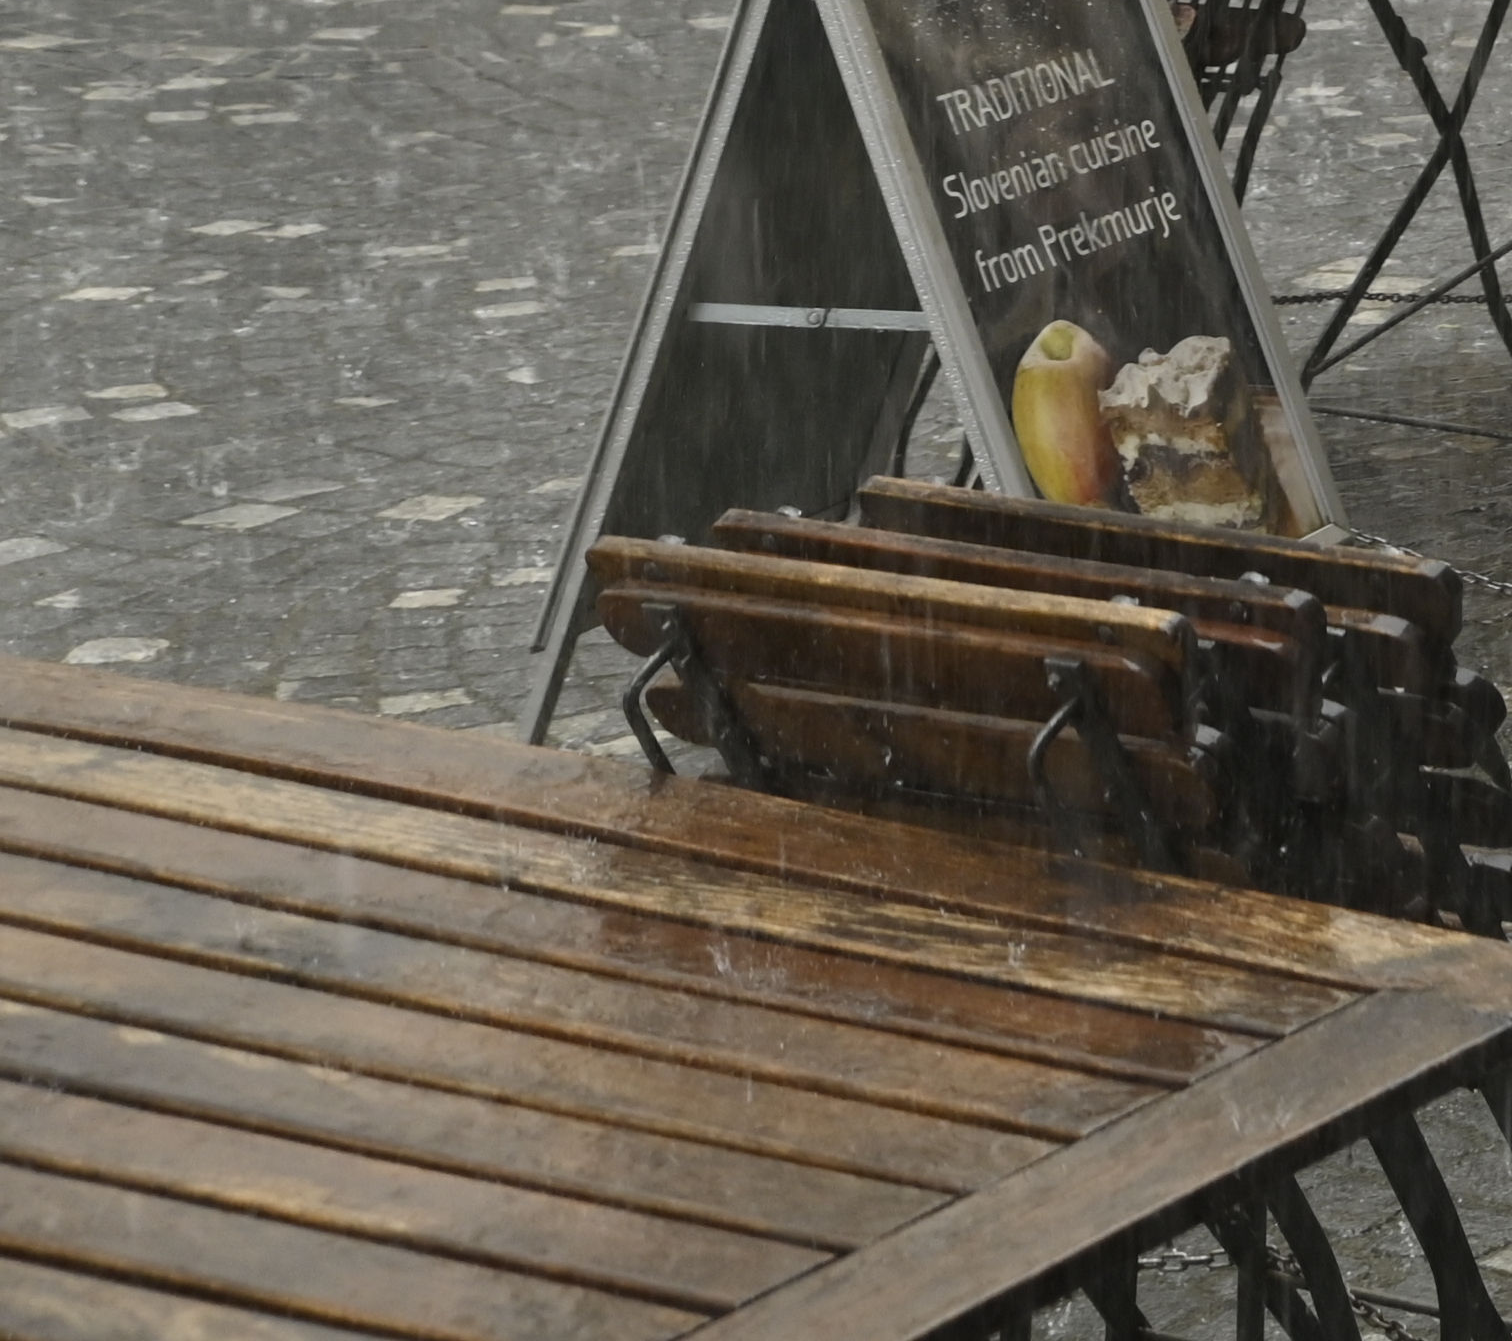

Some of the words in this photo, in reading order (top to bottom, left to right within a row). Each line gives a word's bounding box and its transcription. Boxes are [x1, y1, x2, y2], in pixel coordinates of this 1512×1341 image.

[936, 48, 1115, 135] TRADITIONAL
[943, 150, 1068, 219] Slovenian
[1069, 119, 1160, 174] cuisine
[975, 243, 1044, 292] from
[1038, 186, 1181, 267] Prekmurje
